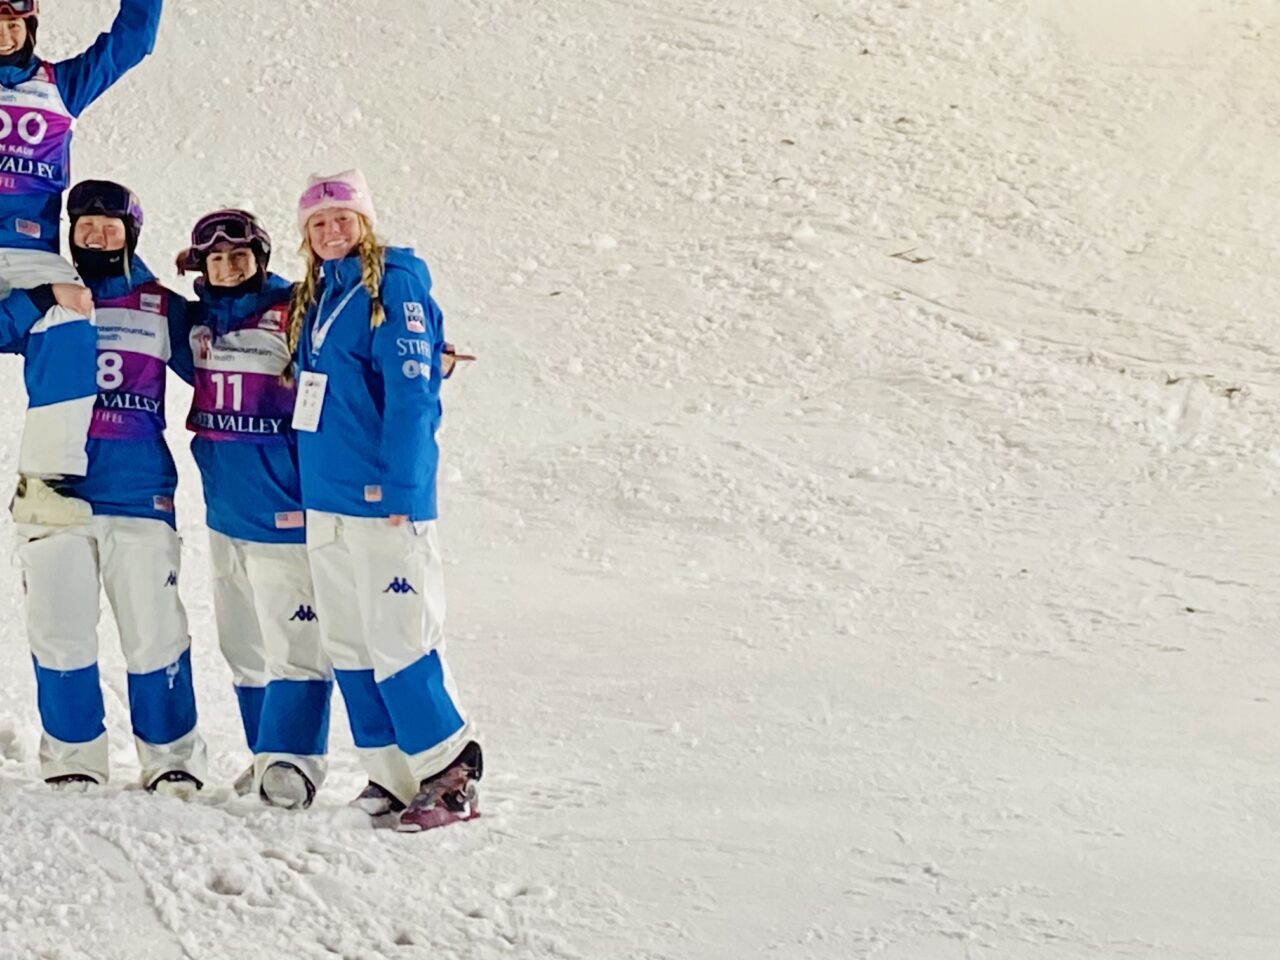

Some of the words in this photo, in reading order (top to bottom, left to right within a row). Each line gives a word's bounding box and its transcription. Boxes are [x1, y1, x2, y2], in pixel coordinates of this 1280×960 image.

[97, 326, 156, 338] ntermountain
[97, 332, 122, 342] ealth
[96, 351, 124, 390] 8
[210, 372, 243, 412] 11
[100, 393, 161, 415] VALLEY
[216, 414, 283, 434] VALLEY
